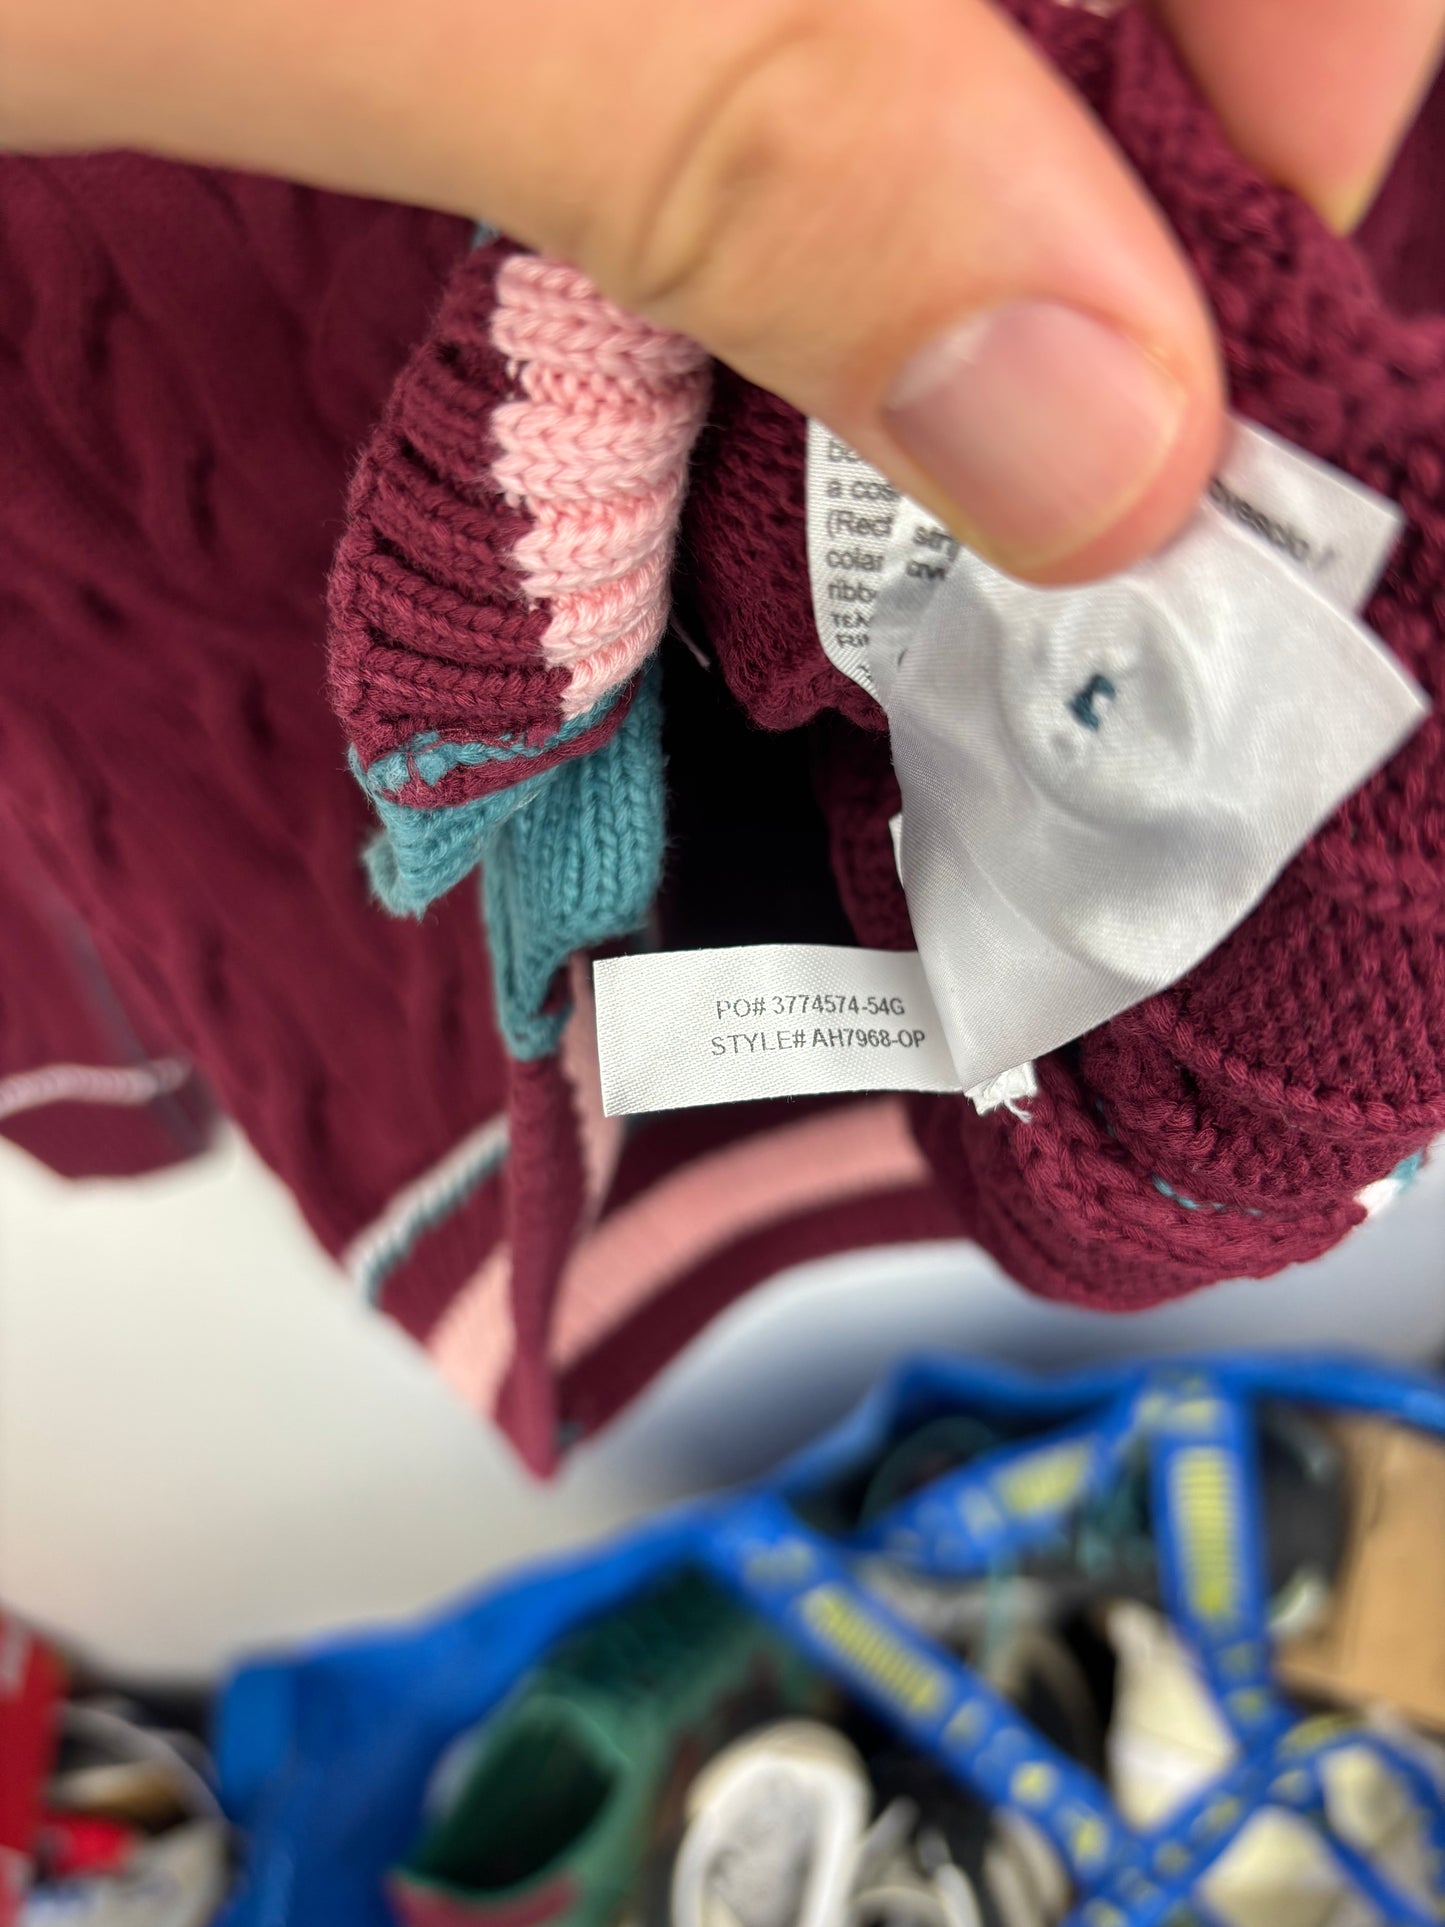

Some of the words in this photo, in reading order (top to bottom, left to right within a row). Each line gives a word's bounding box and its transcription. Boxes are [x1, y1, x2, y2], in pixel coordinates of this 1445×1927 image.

[716, 996, 767, 1020] PO#
[772, 994, 906, 1016] 3774574-54G
[711, 1029, 806, 1056] STYLE#
[812, 1027, 926, 1049] AH7968-OP
